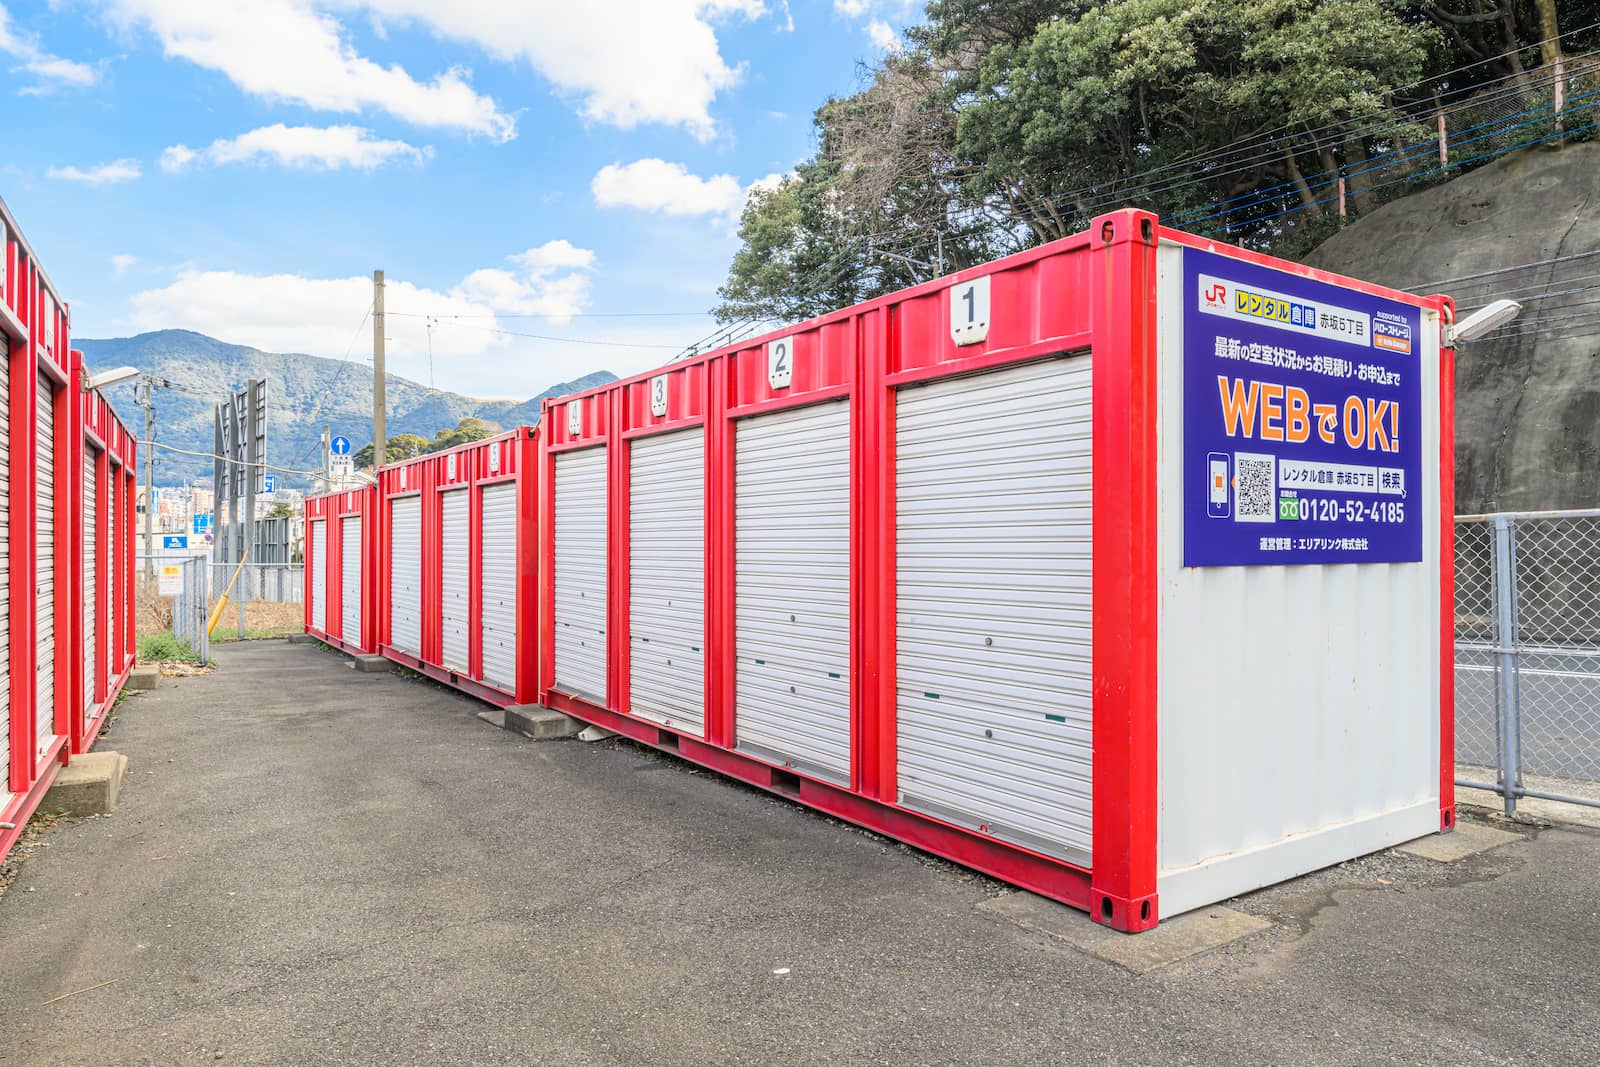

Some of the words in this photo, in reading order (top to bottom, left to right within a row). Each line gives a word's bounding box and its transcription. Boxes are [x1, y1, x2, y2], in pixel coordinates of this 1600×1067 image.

[962, 286, 975, 322] 1
[1205, 284, 1226, 305] JR
[1236, 291, 1316, 328] レンタル倉庫
[1319, 312, 1364, 336] 赤坂5丁目
[774, 343, 786, 372] 2
[1214, 335, 1401, 386] 最新の空室状況からお見積り・お申込まで
[655, 379, 663, 403] 3
[1283, 467, 1334, 485] レンタル倉庫
[1336, 471, 1374, 487] 赤坂5丁目
[1382, 472, 1401, 489] 検索
[1299, 498, 1404, 523] 0120-52-4185
